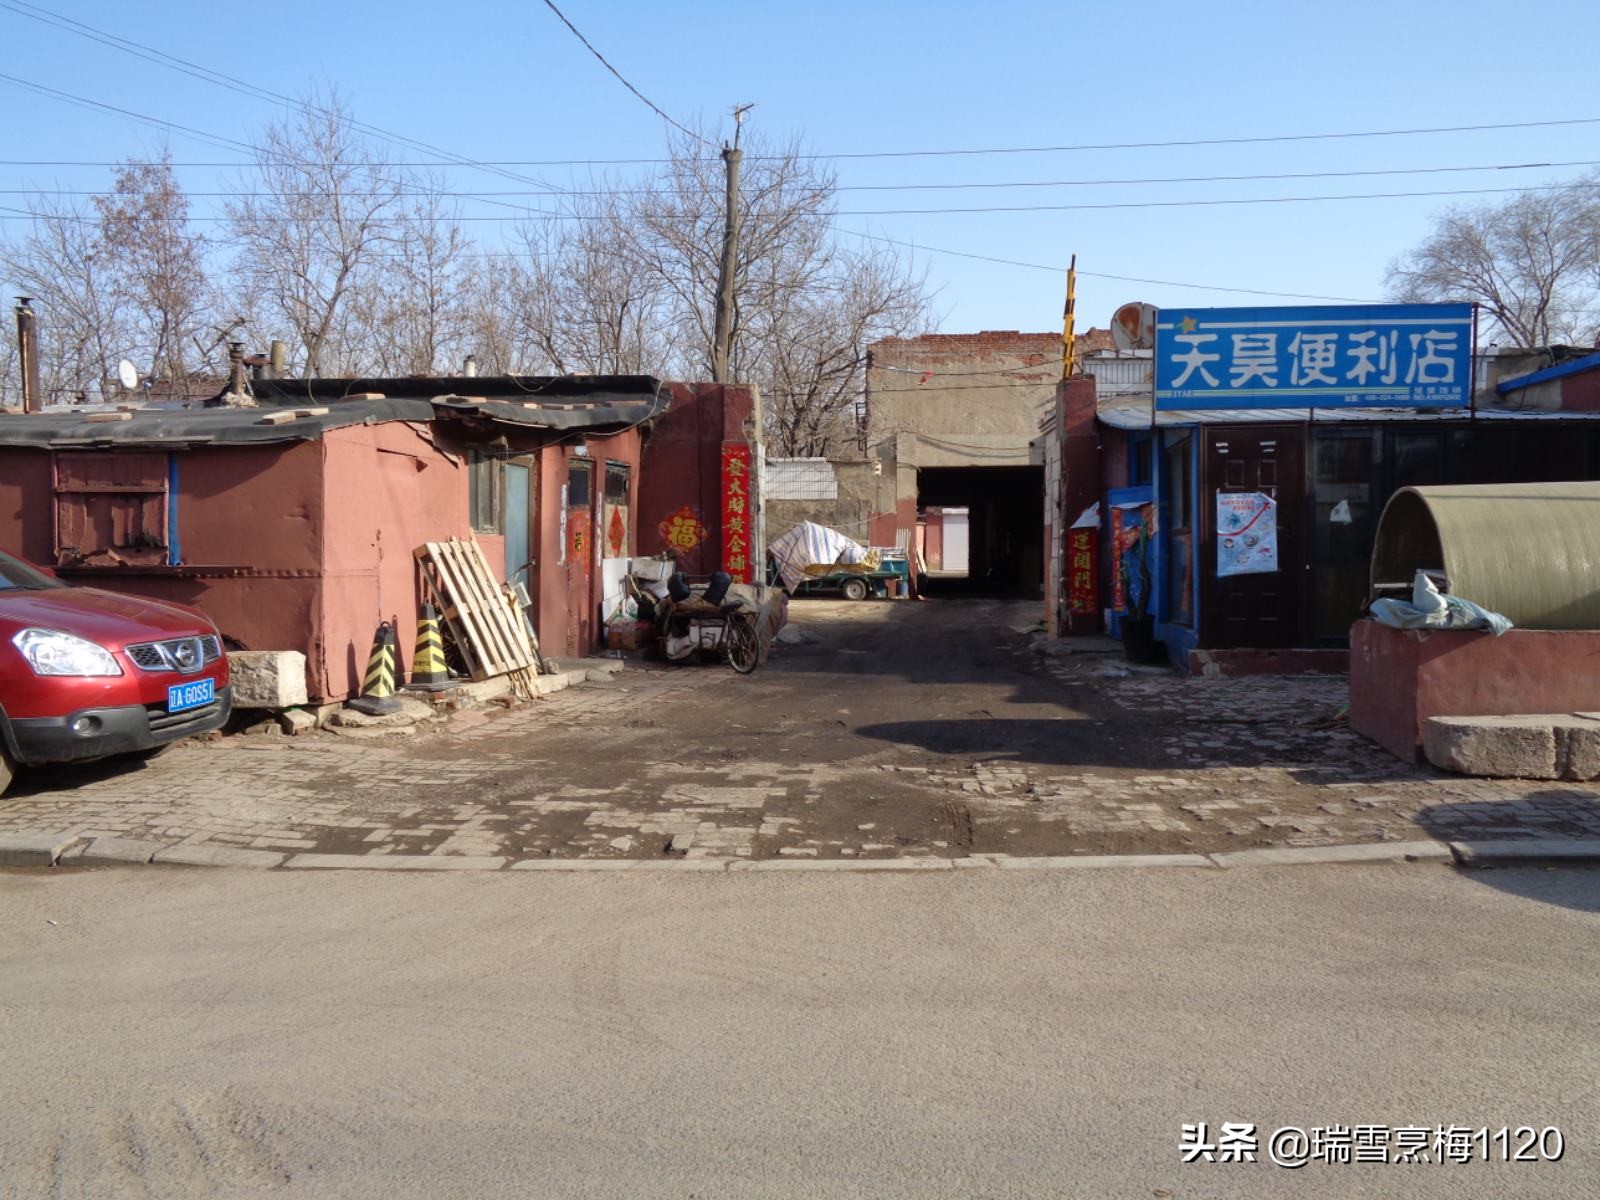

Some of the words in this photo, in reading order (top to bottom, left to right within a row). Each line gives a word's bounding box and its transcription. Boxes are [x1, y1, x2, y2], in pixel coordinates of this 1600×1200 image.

[1171, 330, 1459, 388] 天昊便利店
[667, 516, 698, 549] 福
